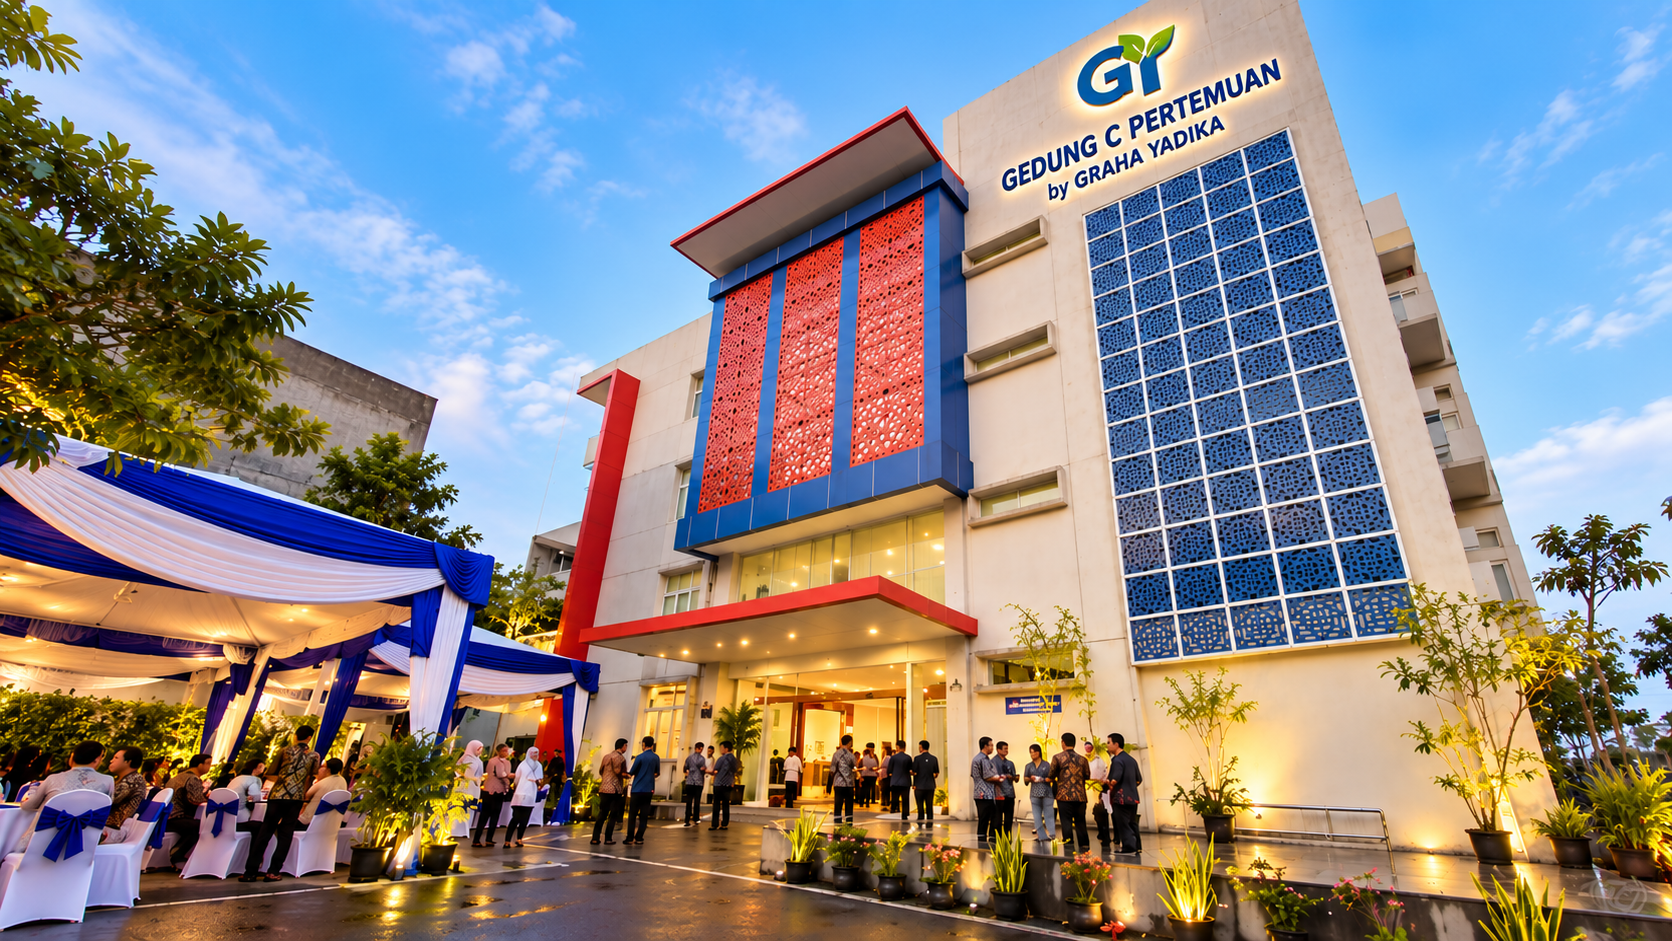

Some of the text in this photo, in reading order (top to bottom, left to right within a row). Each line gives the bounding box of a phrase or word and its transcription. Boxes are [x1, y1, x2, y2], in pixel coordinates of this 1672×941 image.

[1001, 58, 1282, 191] GEDUNG C PERTEMUAN
[1047, 115, 1225, 200] by GRAHA YADIKA
